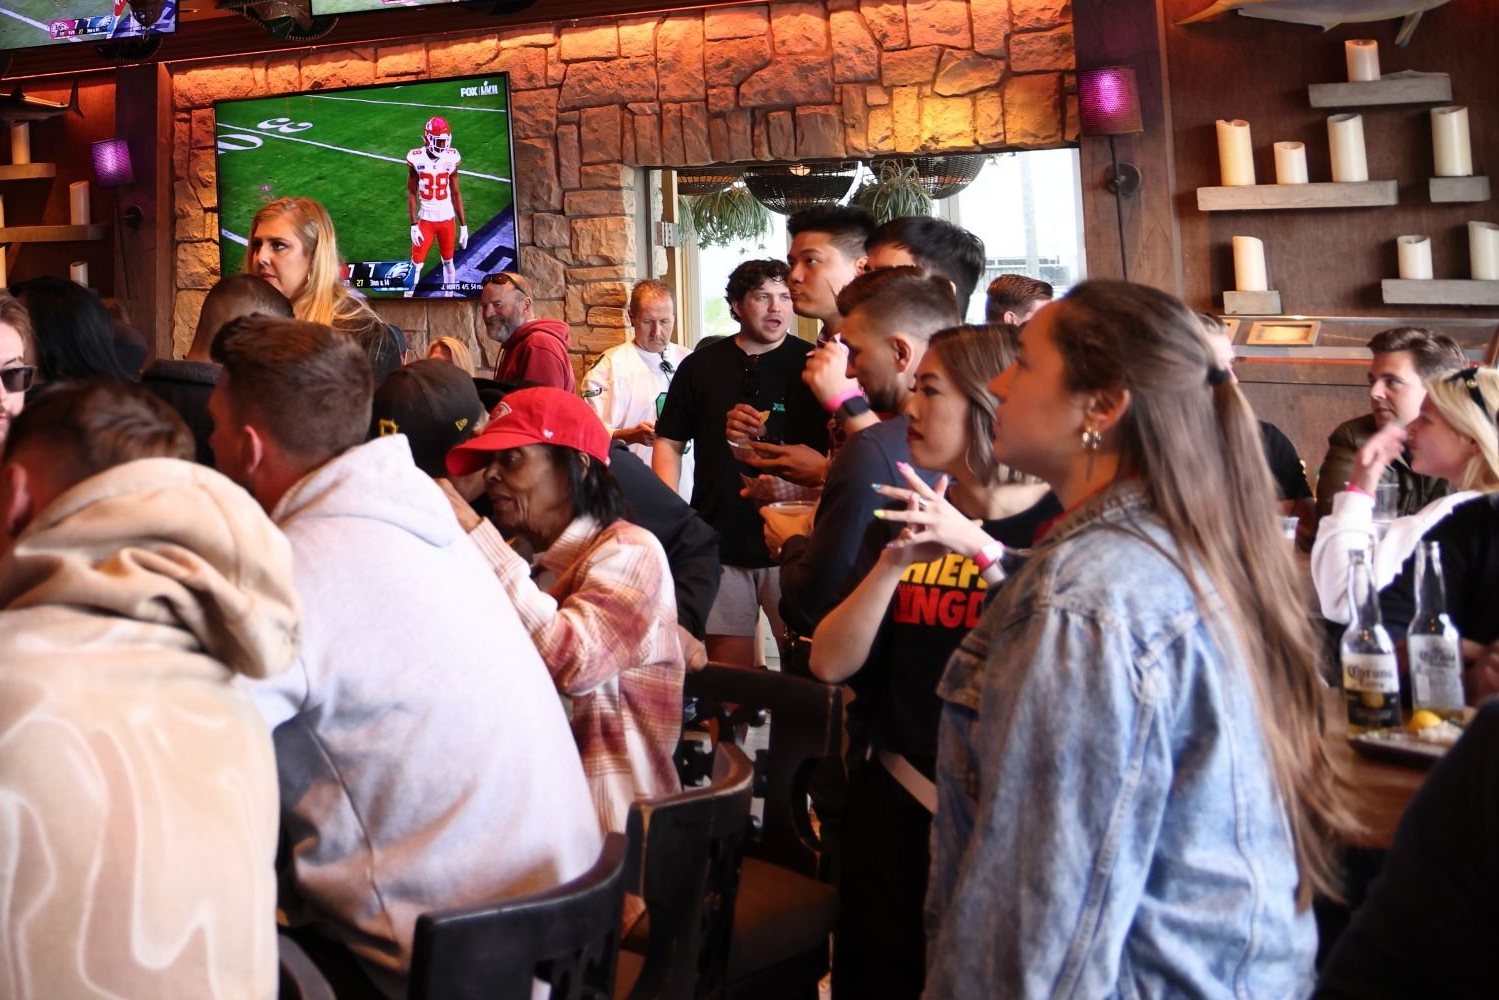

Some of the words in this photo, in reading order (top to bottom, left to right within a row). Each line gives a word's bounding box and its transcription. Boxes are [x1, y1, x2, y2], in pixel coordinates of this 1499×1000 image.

[460, 86, 477, 97] FOX
[419, 172, 450, 200] 38
[348, 264, 355, 278] 7
[368, 263, 375, 278] 7
